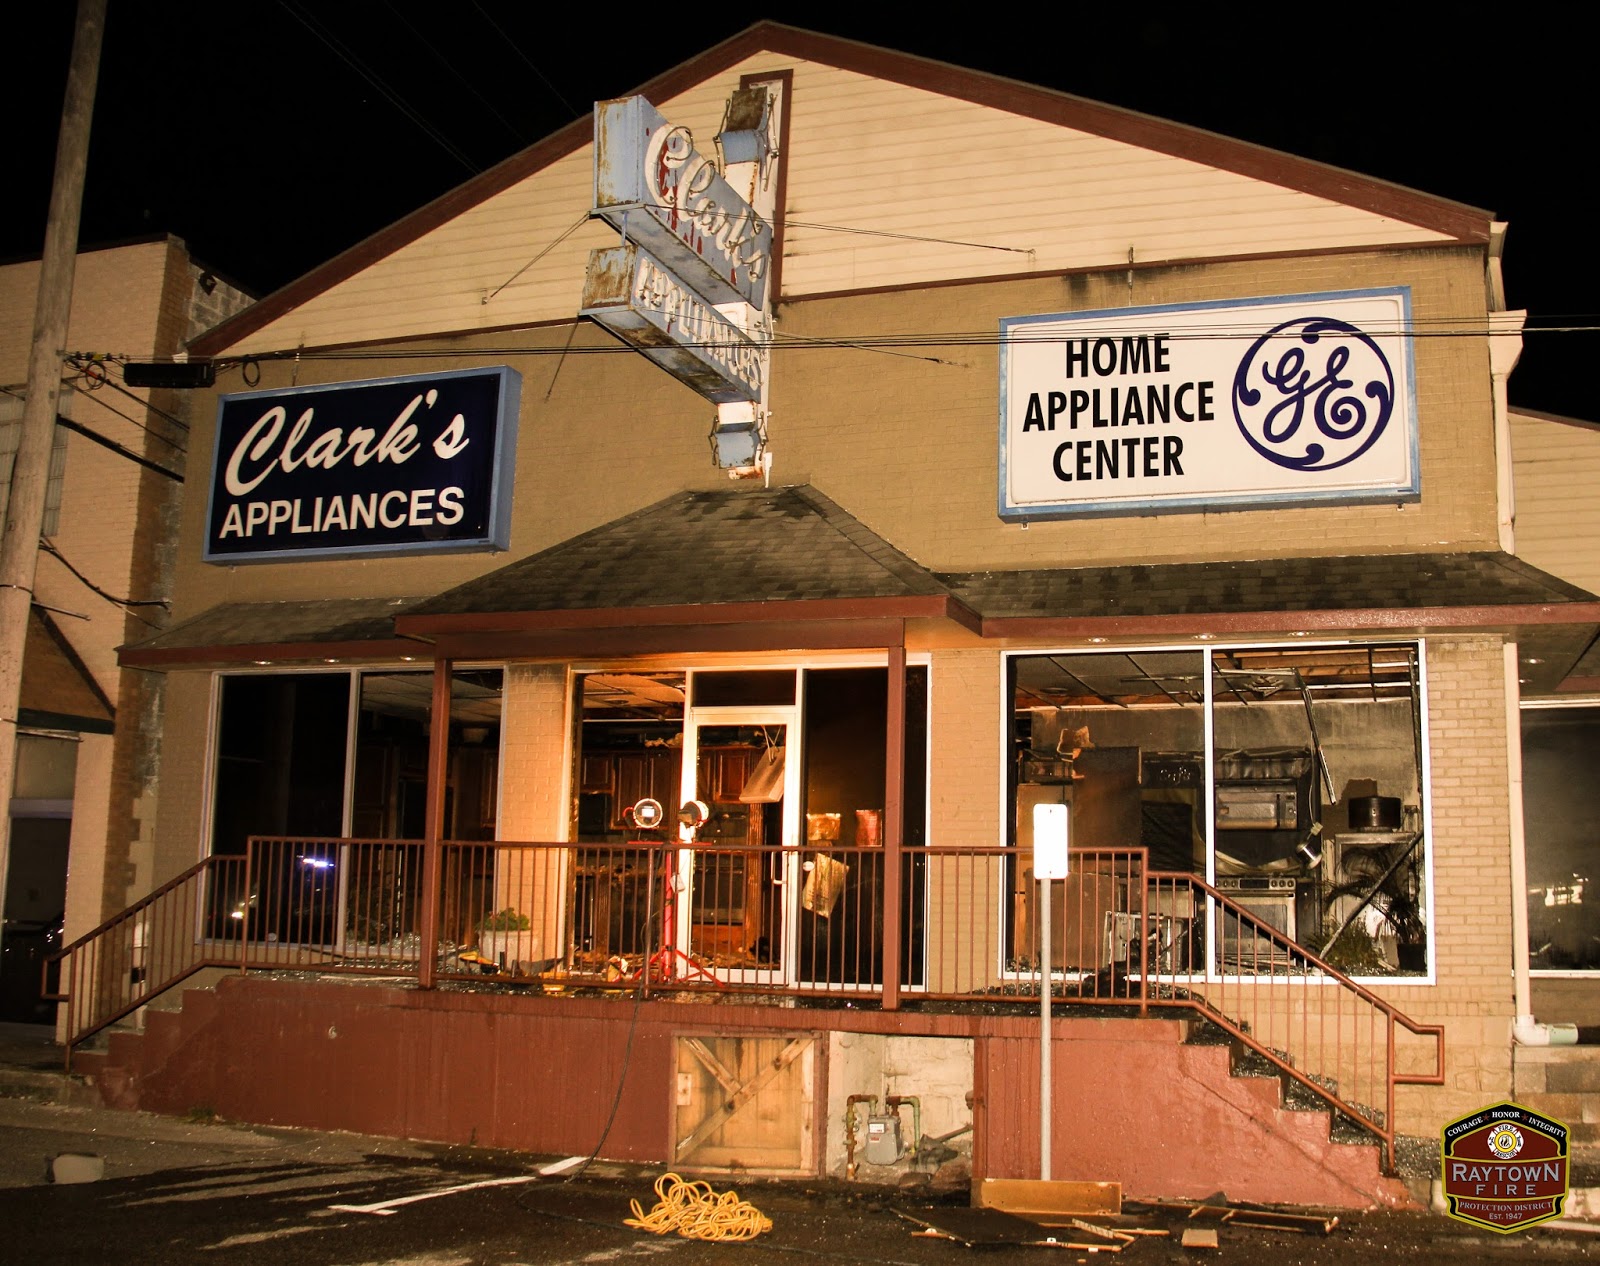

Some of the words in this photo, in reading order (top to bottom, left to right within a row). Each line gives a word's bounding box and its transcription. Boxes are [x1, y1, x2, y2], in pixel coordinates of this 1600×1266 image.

[1066, 332, 1170, 379] HOME
[1022, 381, 1214, 432] APPLIANCE
[225, 388, 470, 496] Clark's
[1052, 435, 1185, 482] CENTER
[218, 486, 465, 539] APPLIANCES
